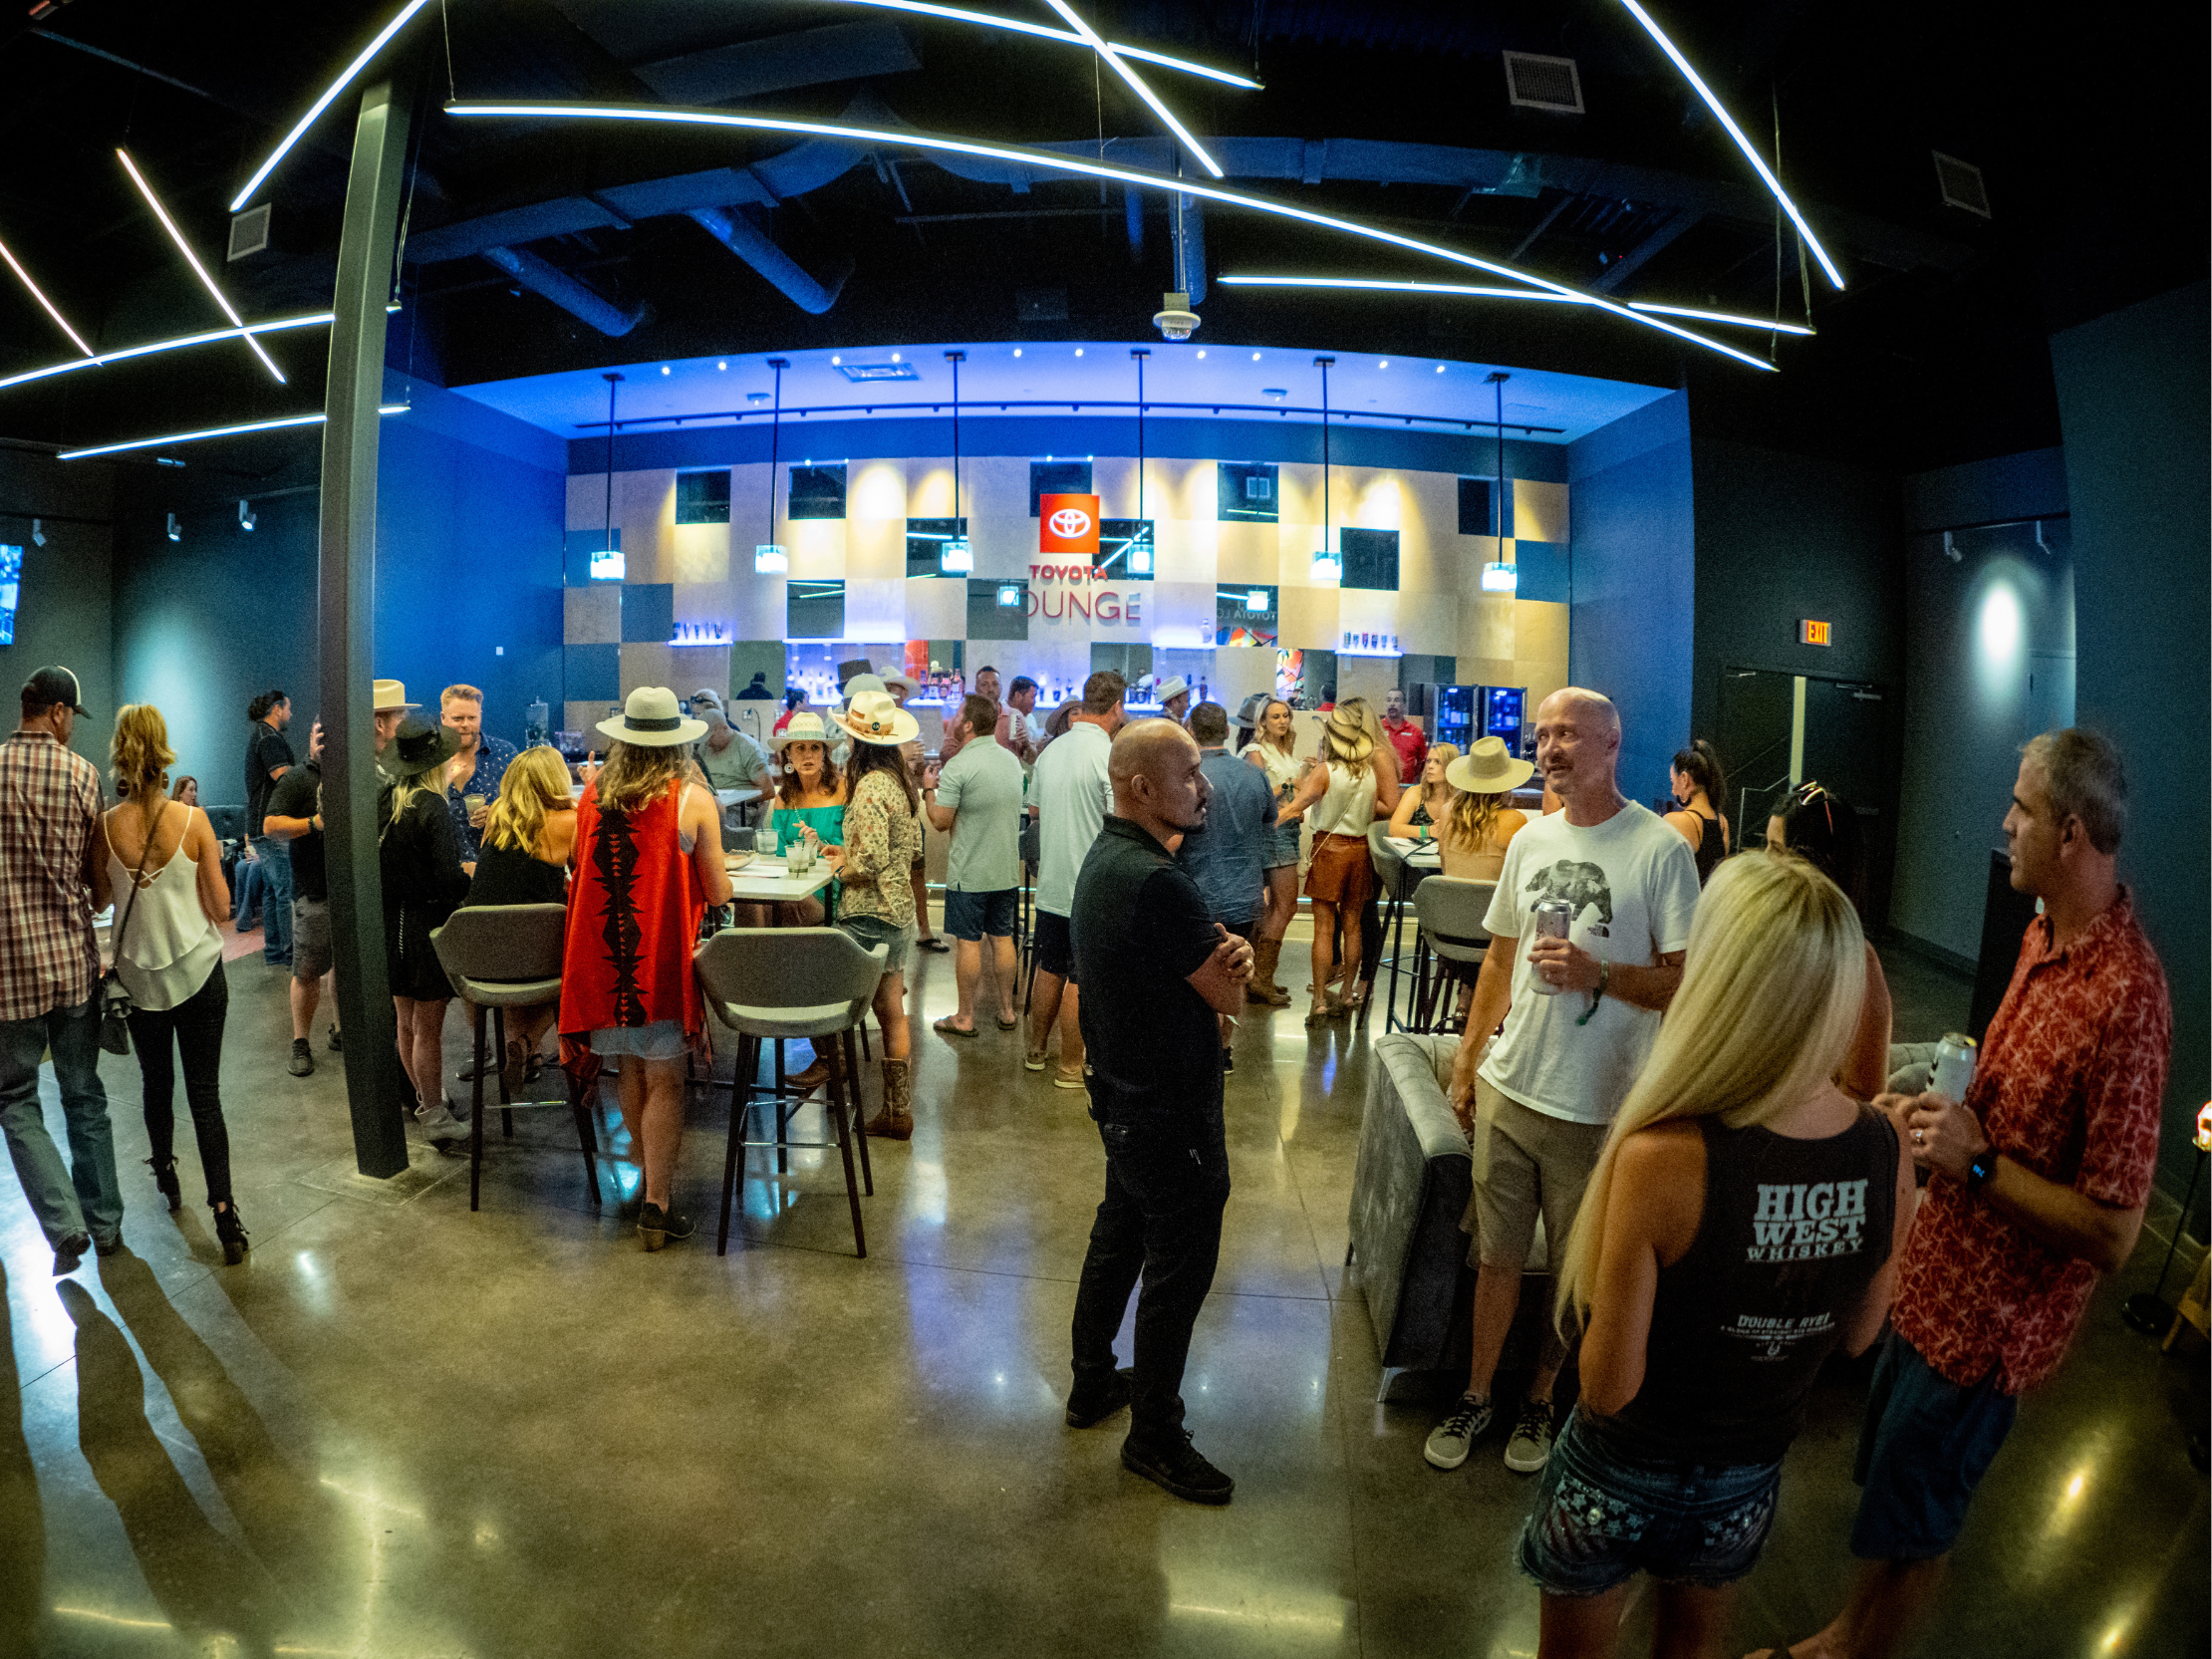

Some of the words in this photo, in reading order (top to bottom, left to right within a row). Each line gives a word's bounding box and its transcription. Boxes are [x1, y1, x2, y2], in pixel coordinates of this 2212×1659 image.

[1029, 564, 1108, 581] TOYOTA
[1806, 620, 1829, 645] EXIT
[1754, 1178, 1868, 1222] HIGH
[1753, 1214, 1866, 1245] WEST
[1747, 1238, 1863, 1261] WHISKEY
[1737, 1314, 1796, 1329] DOUBLE
